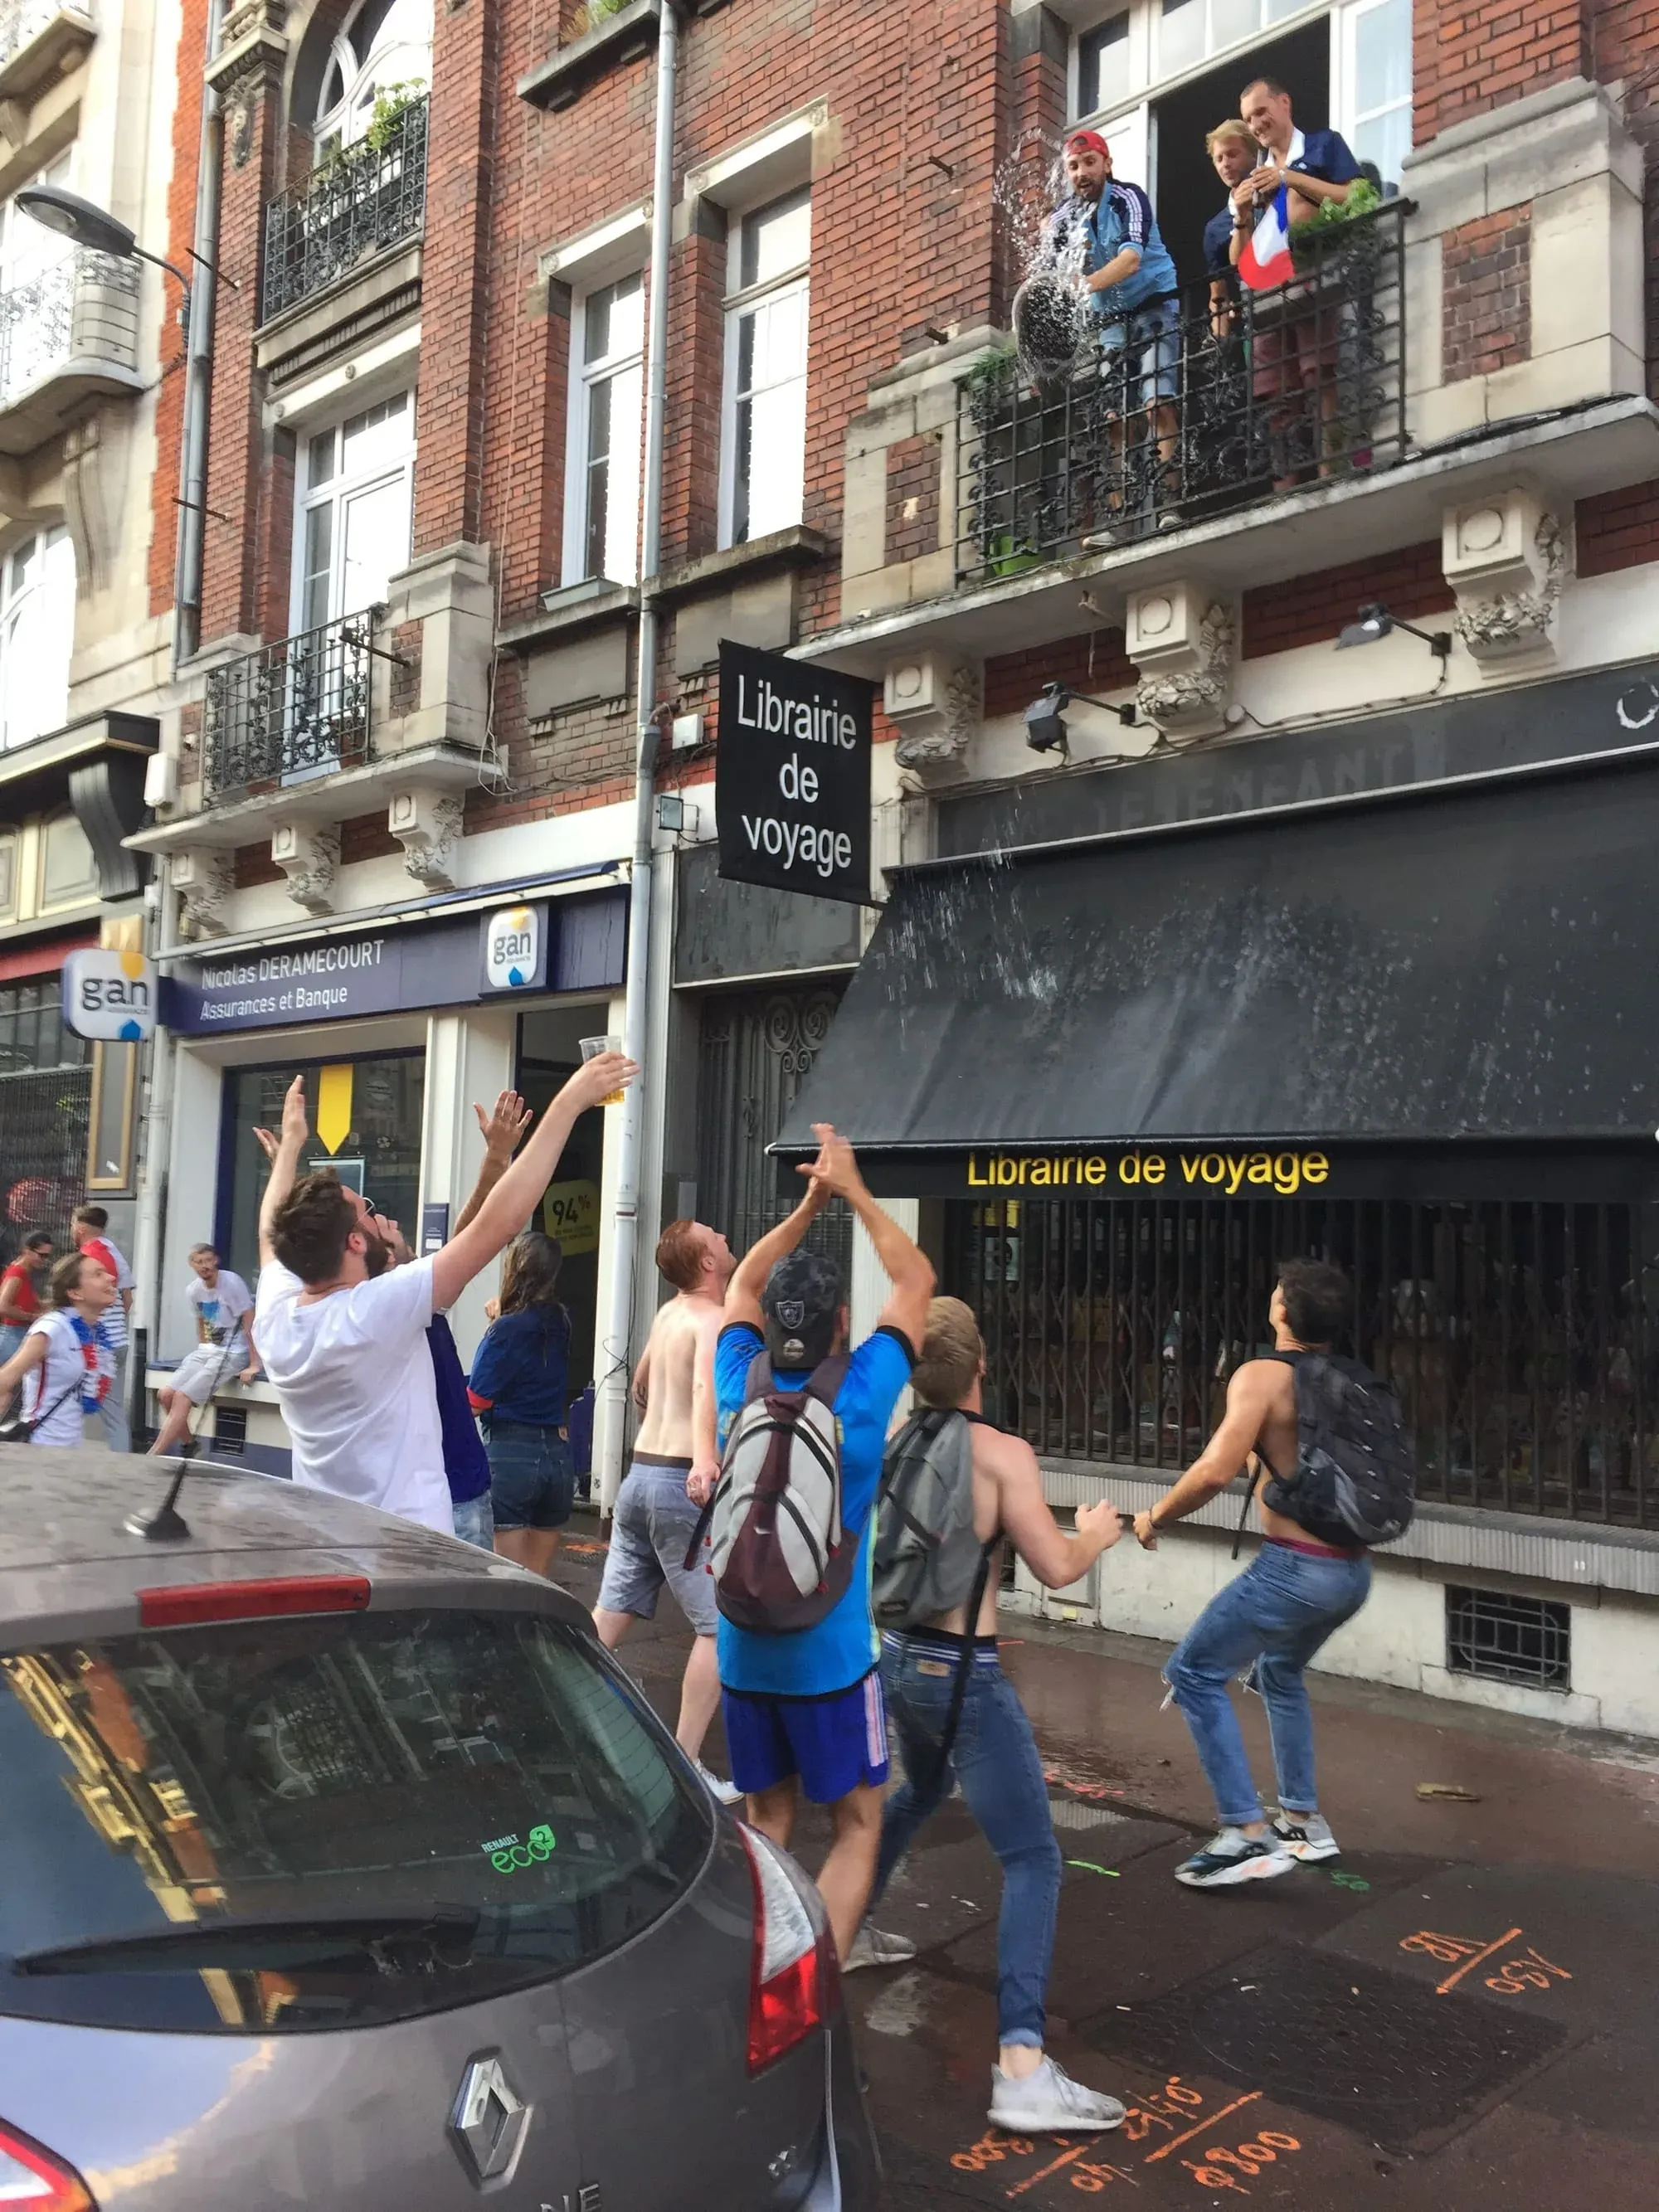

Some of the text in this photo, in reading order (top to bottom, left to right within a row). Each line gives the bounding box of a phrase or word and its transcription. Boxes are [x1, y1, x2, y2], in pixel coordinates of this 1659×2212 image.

[737, 674, 857, 750] Librairie
[779, 752, 819, 803] de
[742, 814, 852, 878] voyage
[202, 940, 385, 990] Nicolas DERAMECOURT
[494, 932, 531, 965] gan
[82, 978, 148, 1011] gan
[200, 987, 348, 1021] Assurances et Banque
[967, 1150, 1329, 1194] Librairie de voyage
[481, 1833, 520, 1854] RENAULT
